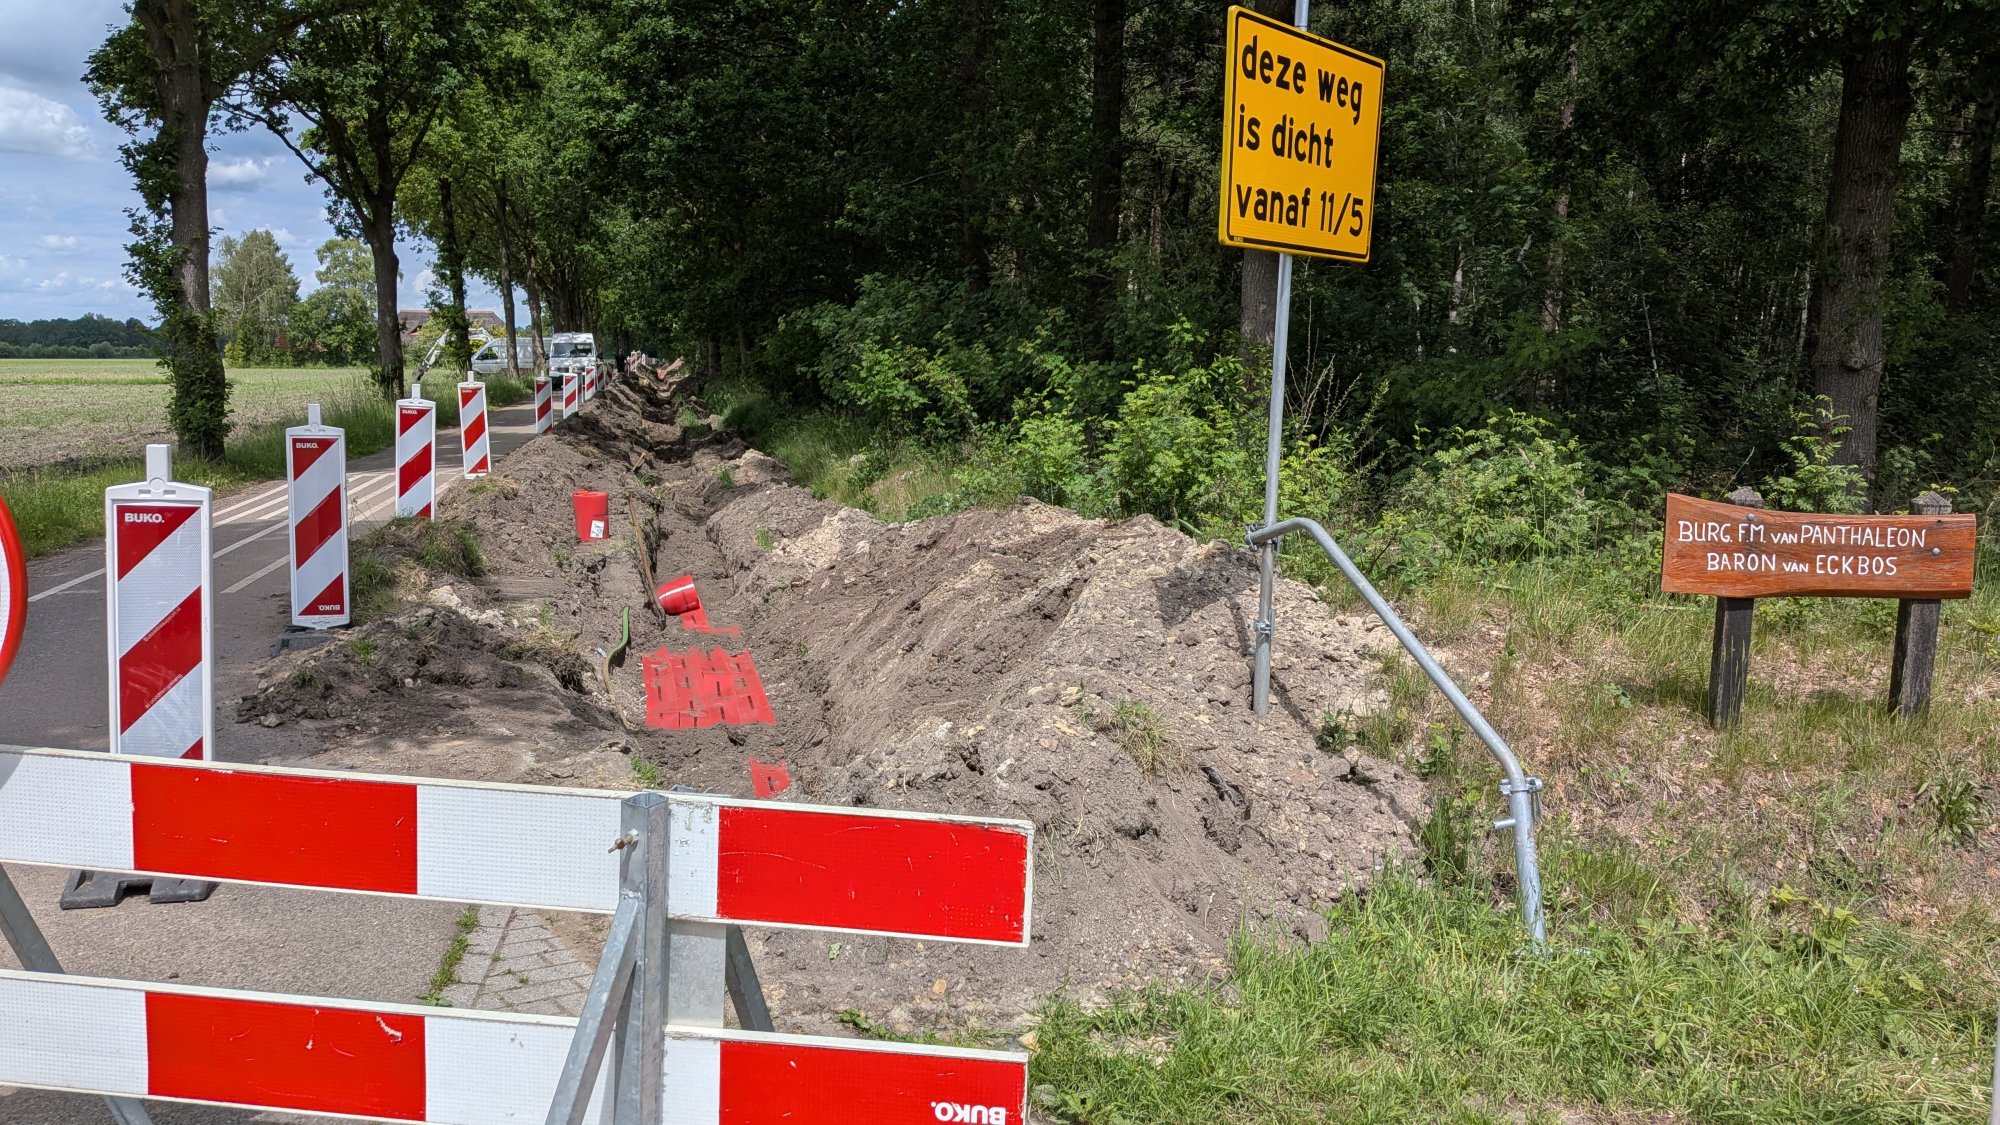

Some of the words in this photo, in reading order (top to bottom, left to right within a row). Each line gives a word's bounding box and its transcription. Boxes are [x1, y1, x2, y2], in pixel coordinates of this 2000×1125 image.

[1241, 34, 1307, 94] deze
[1317, 68, 1363, 126] weg
[1238, 104, 1261, 151] is
[1271, 113, 1334, 169] dicht
[1236, 184, 1311, 228] vanaf
[1320, 190, 1364, 237] 11/5
[124, 512, 165, 523] BUKO.
[1678, 520, 1733, 543] BURG.
[1738, 522, 1767, 544] F.M.
[1770, 532, 1798, 544] VAN
[1800, 524, 1927, 548] PANTHALEON
[1706, 552, 1776, 572] BARON
[1782, 561, 1809, 573] VAN
[1816, 554, 1898, 576] ECKBOS
[930, 1101, 1007, 1125] BUKO.
